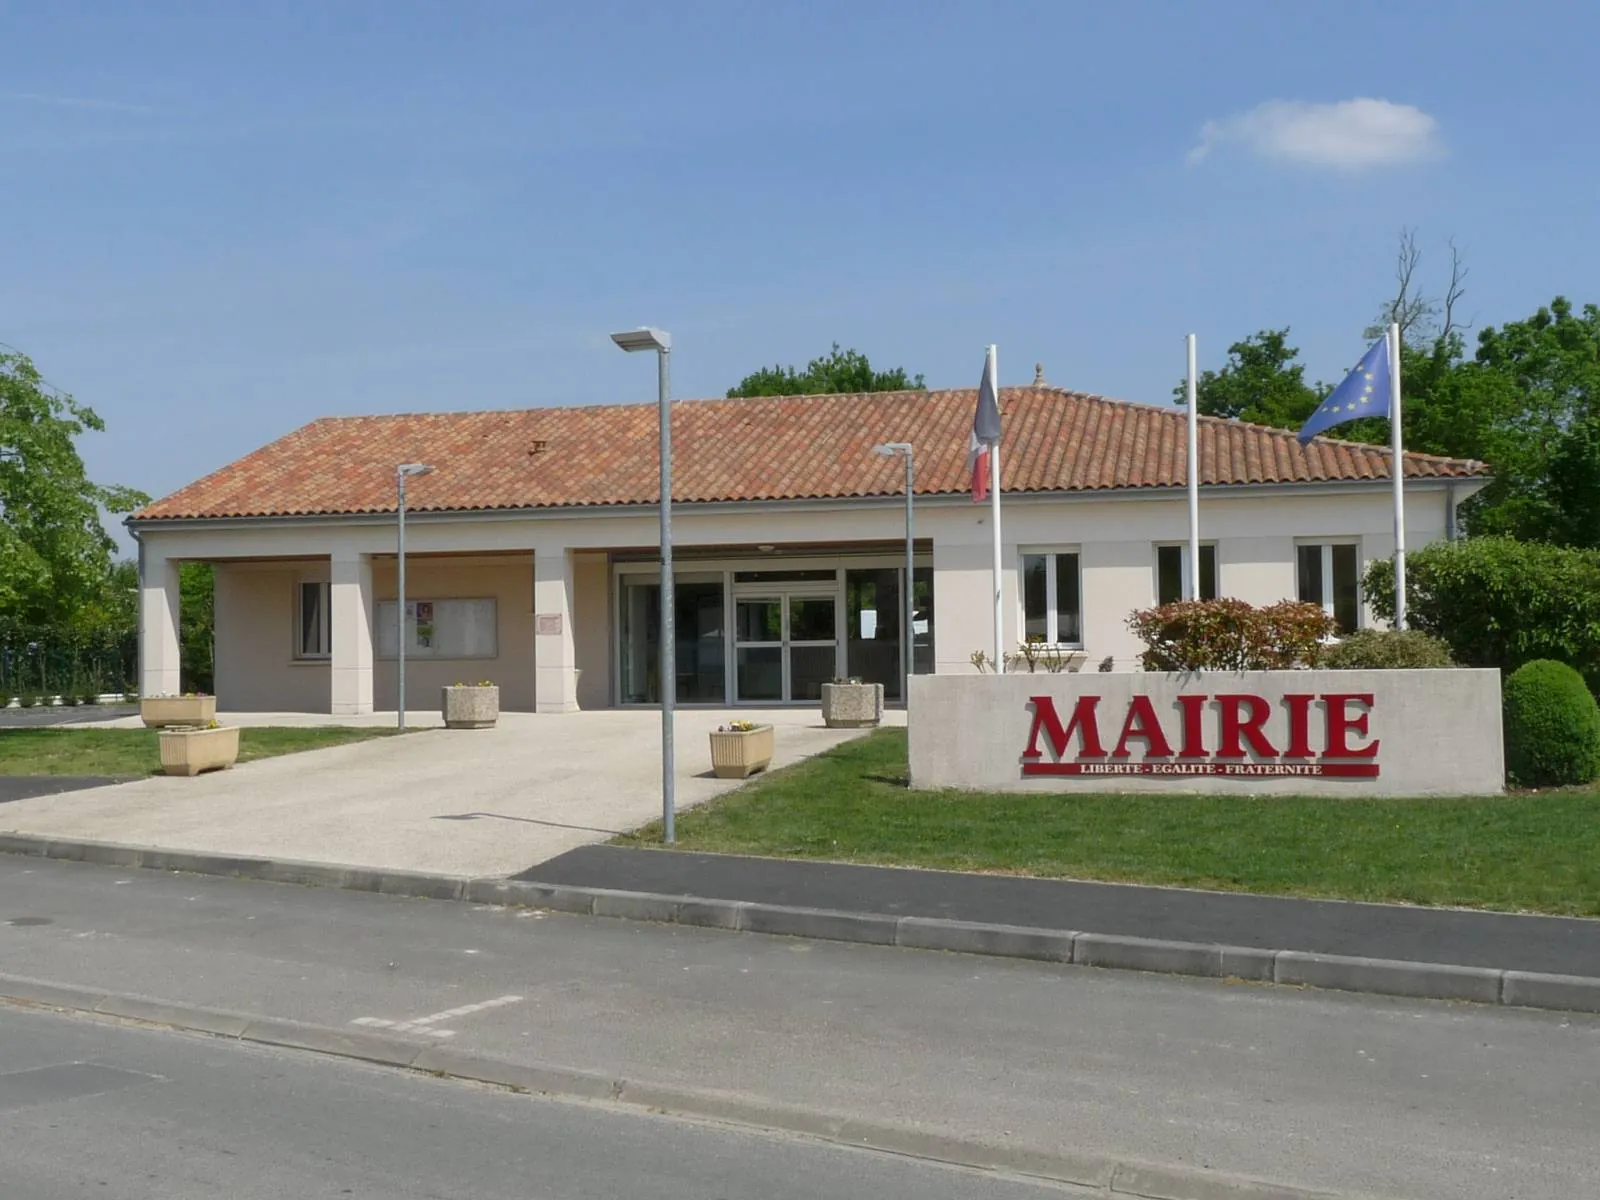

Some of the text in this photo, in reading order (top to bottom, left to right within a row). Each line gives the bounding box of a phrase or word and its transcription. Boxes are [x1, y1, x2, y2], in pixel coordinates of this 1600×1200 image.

[1023, 693, 1380, 758] MAIRIE
[1080, 764, 1143, 774] LIBERTE
[1152, 764, 1216, 774] EGALITE
[1225, 764, 1323, 775] FRATERNITE
